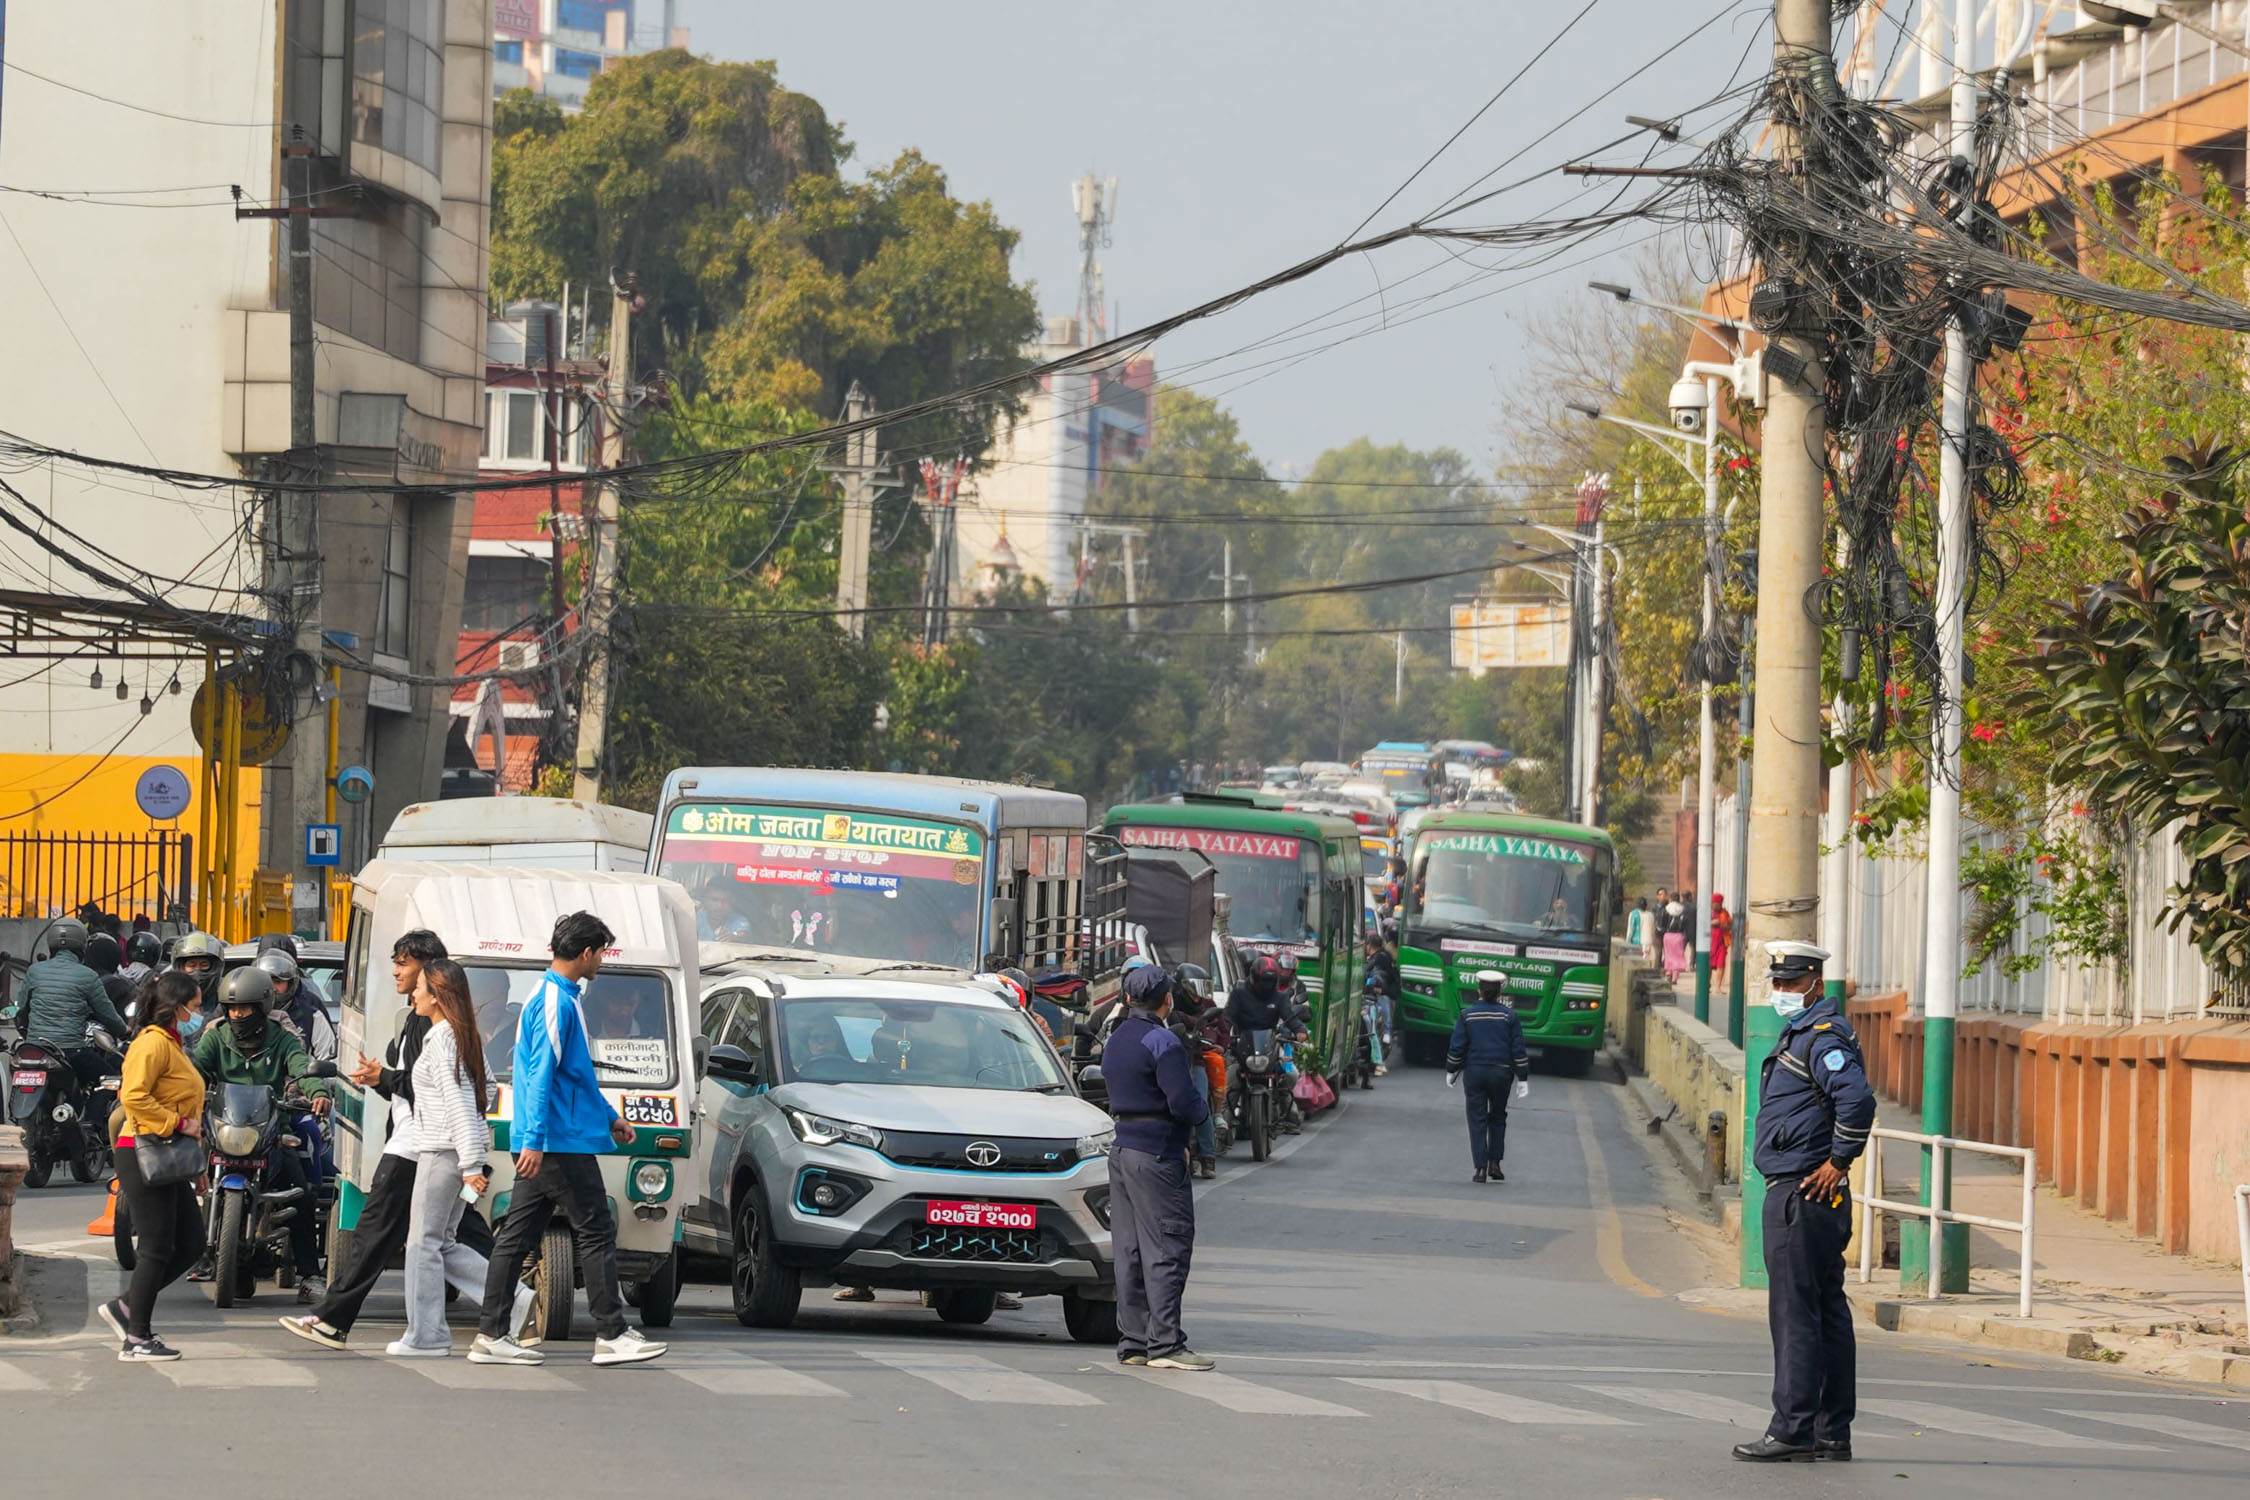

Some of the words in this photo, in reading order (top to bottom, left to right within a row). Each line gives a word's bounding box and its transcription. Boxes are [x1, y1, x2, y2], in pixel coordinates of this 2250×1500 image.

[706, 807, 756, 834] ओम
[758, 814, 821, 838] जनता
[852, 821, 945, 849] यातायात
[1123, 829, 1191, 849] SAJHA
[1197, 833, 1295, 857] YATAYAT
[1430, 836, 1500, 853] SAJHA
[1457, 957, 1498, 967] ASHOK
[1499, 961, 1552, 973] LEYLAND
[1509, 977, 1545, 991] यातायात
[625, 1096, 641, 1106] बा
[1044, 1152, 1059, 1160] EV
[986, 1211, 1032, 1227] २१००
